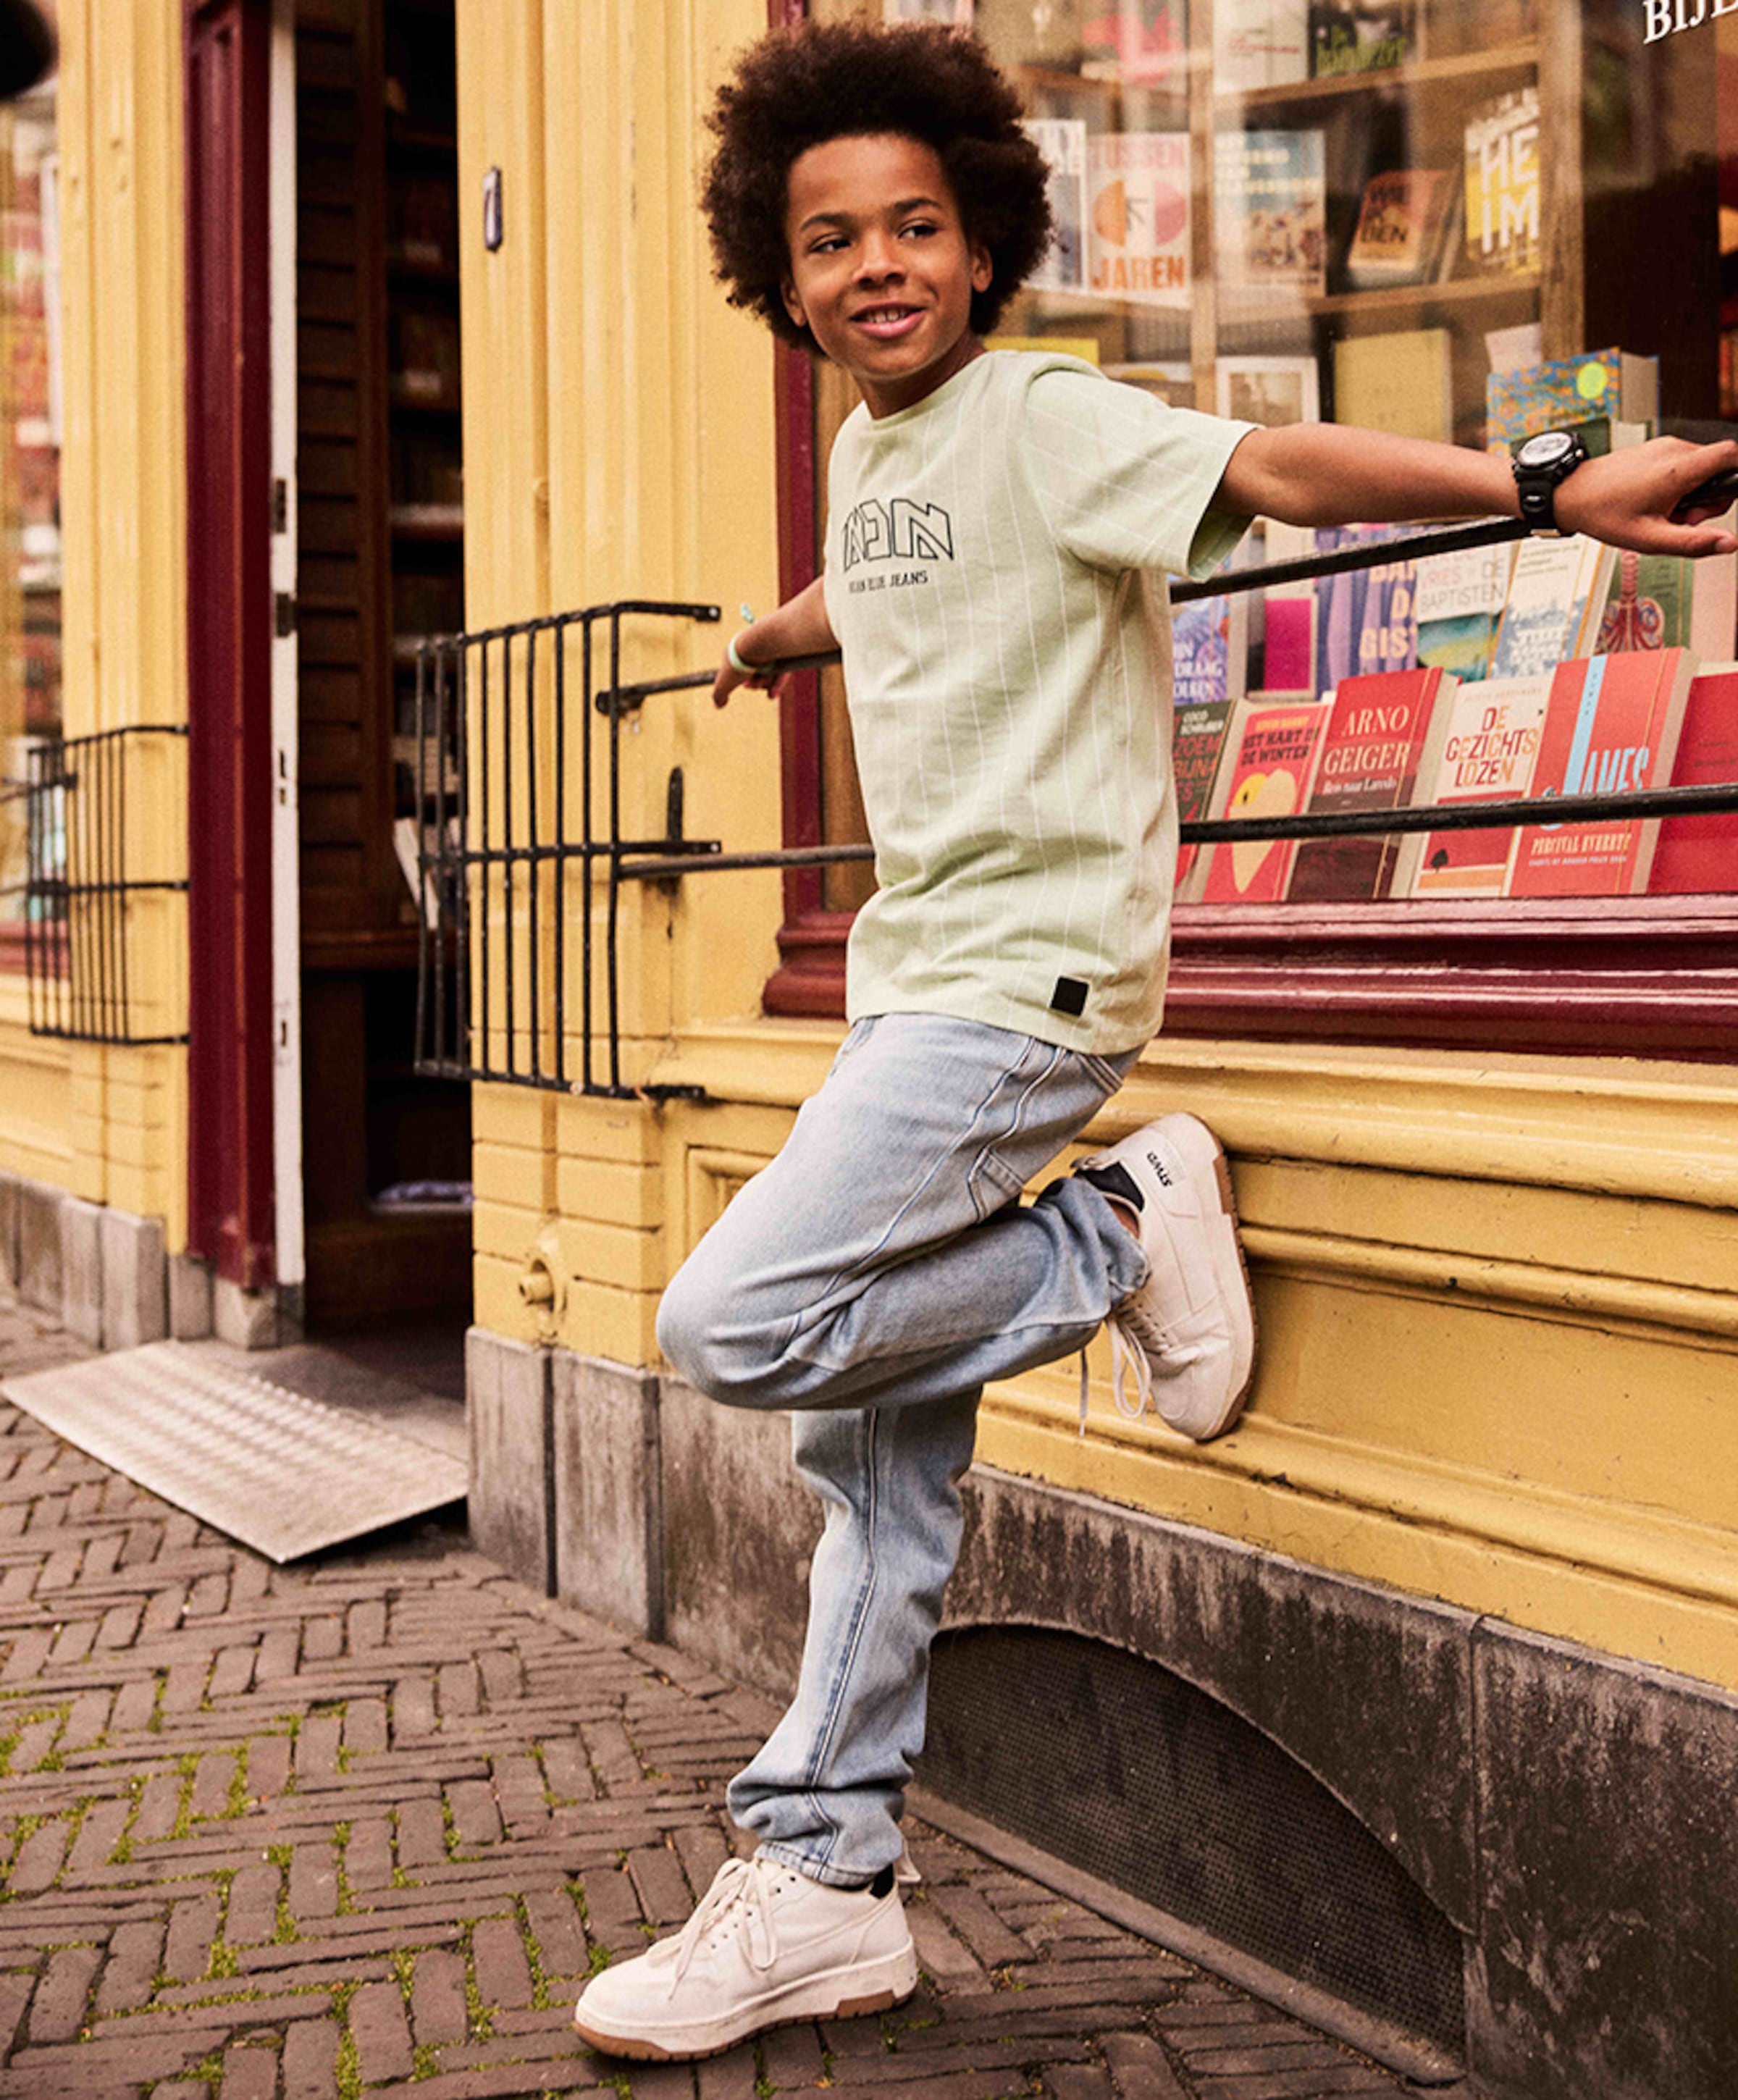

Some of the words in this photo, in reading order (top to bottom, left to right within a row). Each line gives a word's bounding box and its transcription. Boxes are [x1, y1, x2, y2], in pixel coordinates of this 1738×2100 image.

[1091, 255, 1185, 291] JAREN
[889, 570, 929, 588] JEANS
[1420, 583, 1505, 613] BAPTISTEN
[1340, 705, 1410, 738] ARNO
[1482, 705, 1511, 732] DE
[1266, 728, 1303, 745] HART
[1445, 728, 1539, 762] GEZICHTS
[1323, 742, 1412, 776] GEIGER
[1455, 758, 1515, 788] LOZEN
